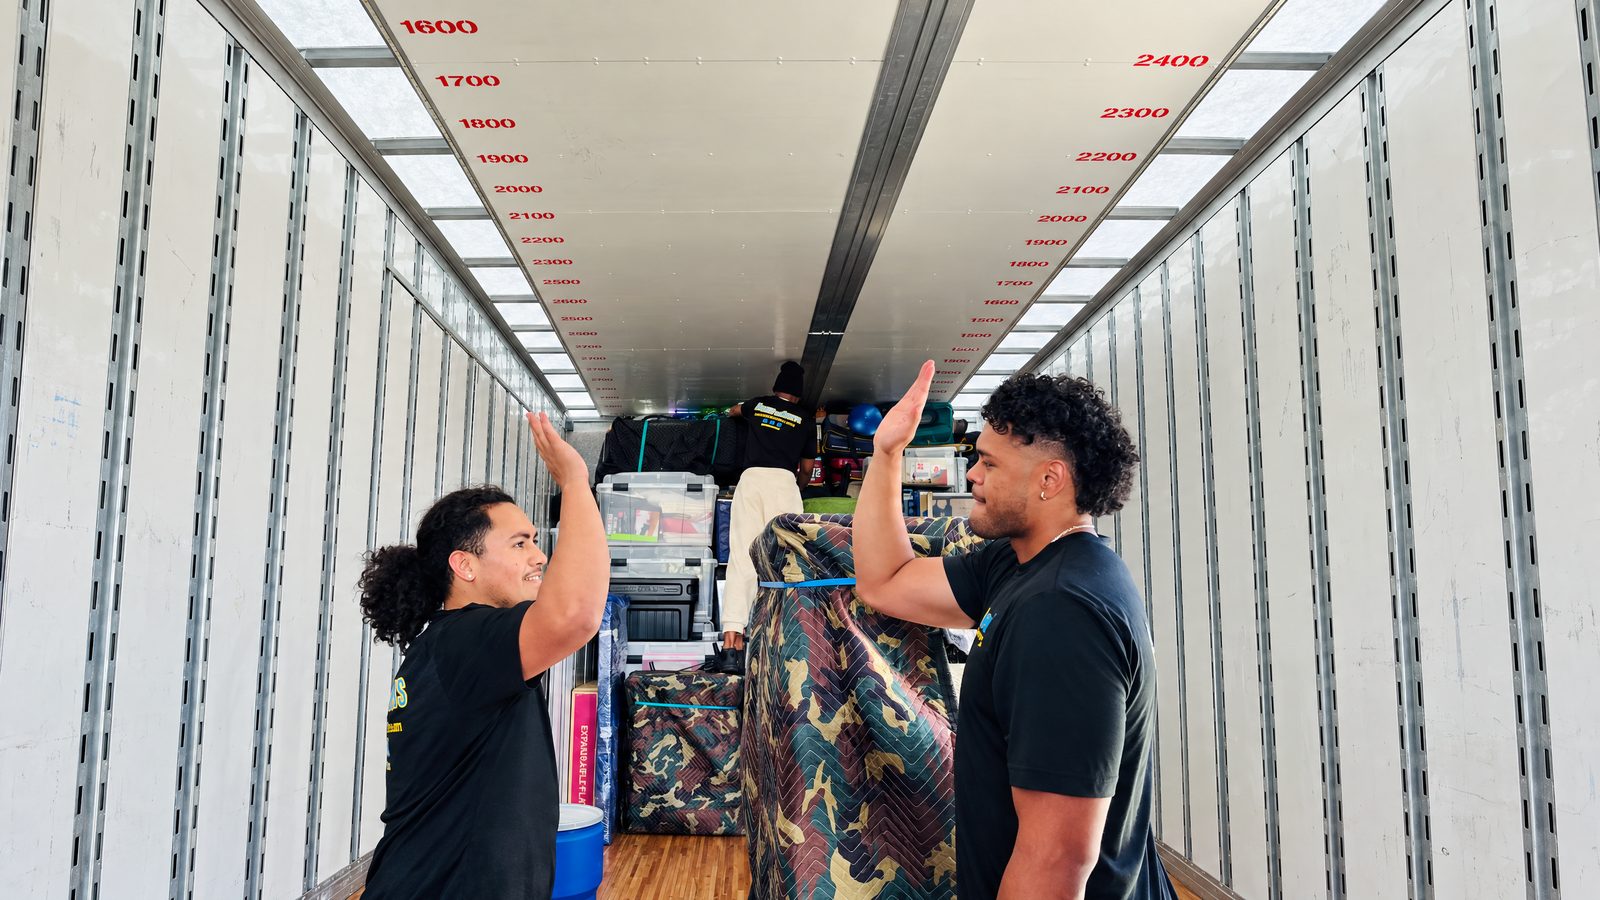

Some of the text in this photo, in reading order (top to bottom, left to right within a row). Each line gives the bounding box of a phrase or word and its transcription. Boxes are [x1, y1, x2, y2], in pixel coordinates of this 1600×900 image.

[400, 19, 479, 36] 1600
[1132, 53, 1210, 68] 2400
[435, 75, 501, 88] 1700
[1099, 107, 1170, 119] 2300
[459, 117, 516, 129] 1800
[477, 153, 529, 165] 1900
[1075, 152, 1137, 163] 2200
[494, 185, 544, 194] 2000
[1056, 185, 1110, 195] 2100
[509, 211, 556, 221] 2100
[1037, 214, 1088, 224] 2000
[521, 236, 565, 245] 2200
[1024, 238, 1068, 247] 1900
[1008, 260, 1050, 268] 1800
[995, 279, 1034, 287] 1700
[969, 316, 1005, 324] 1500
[960, 331, 993, 339] 1500
